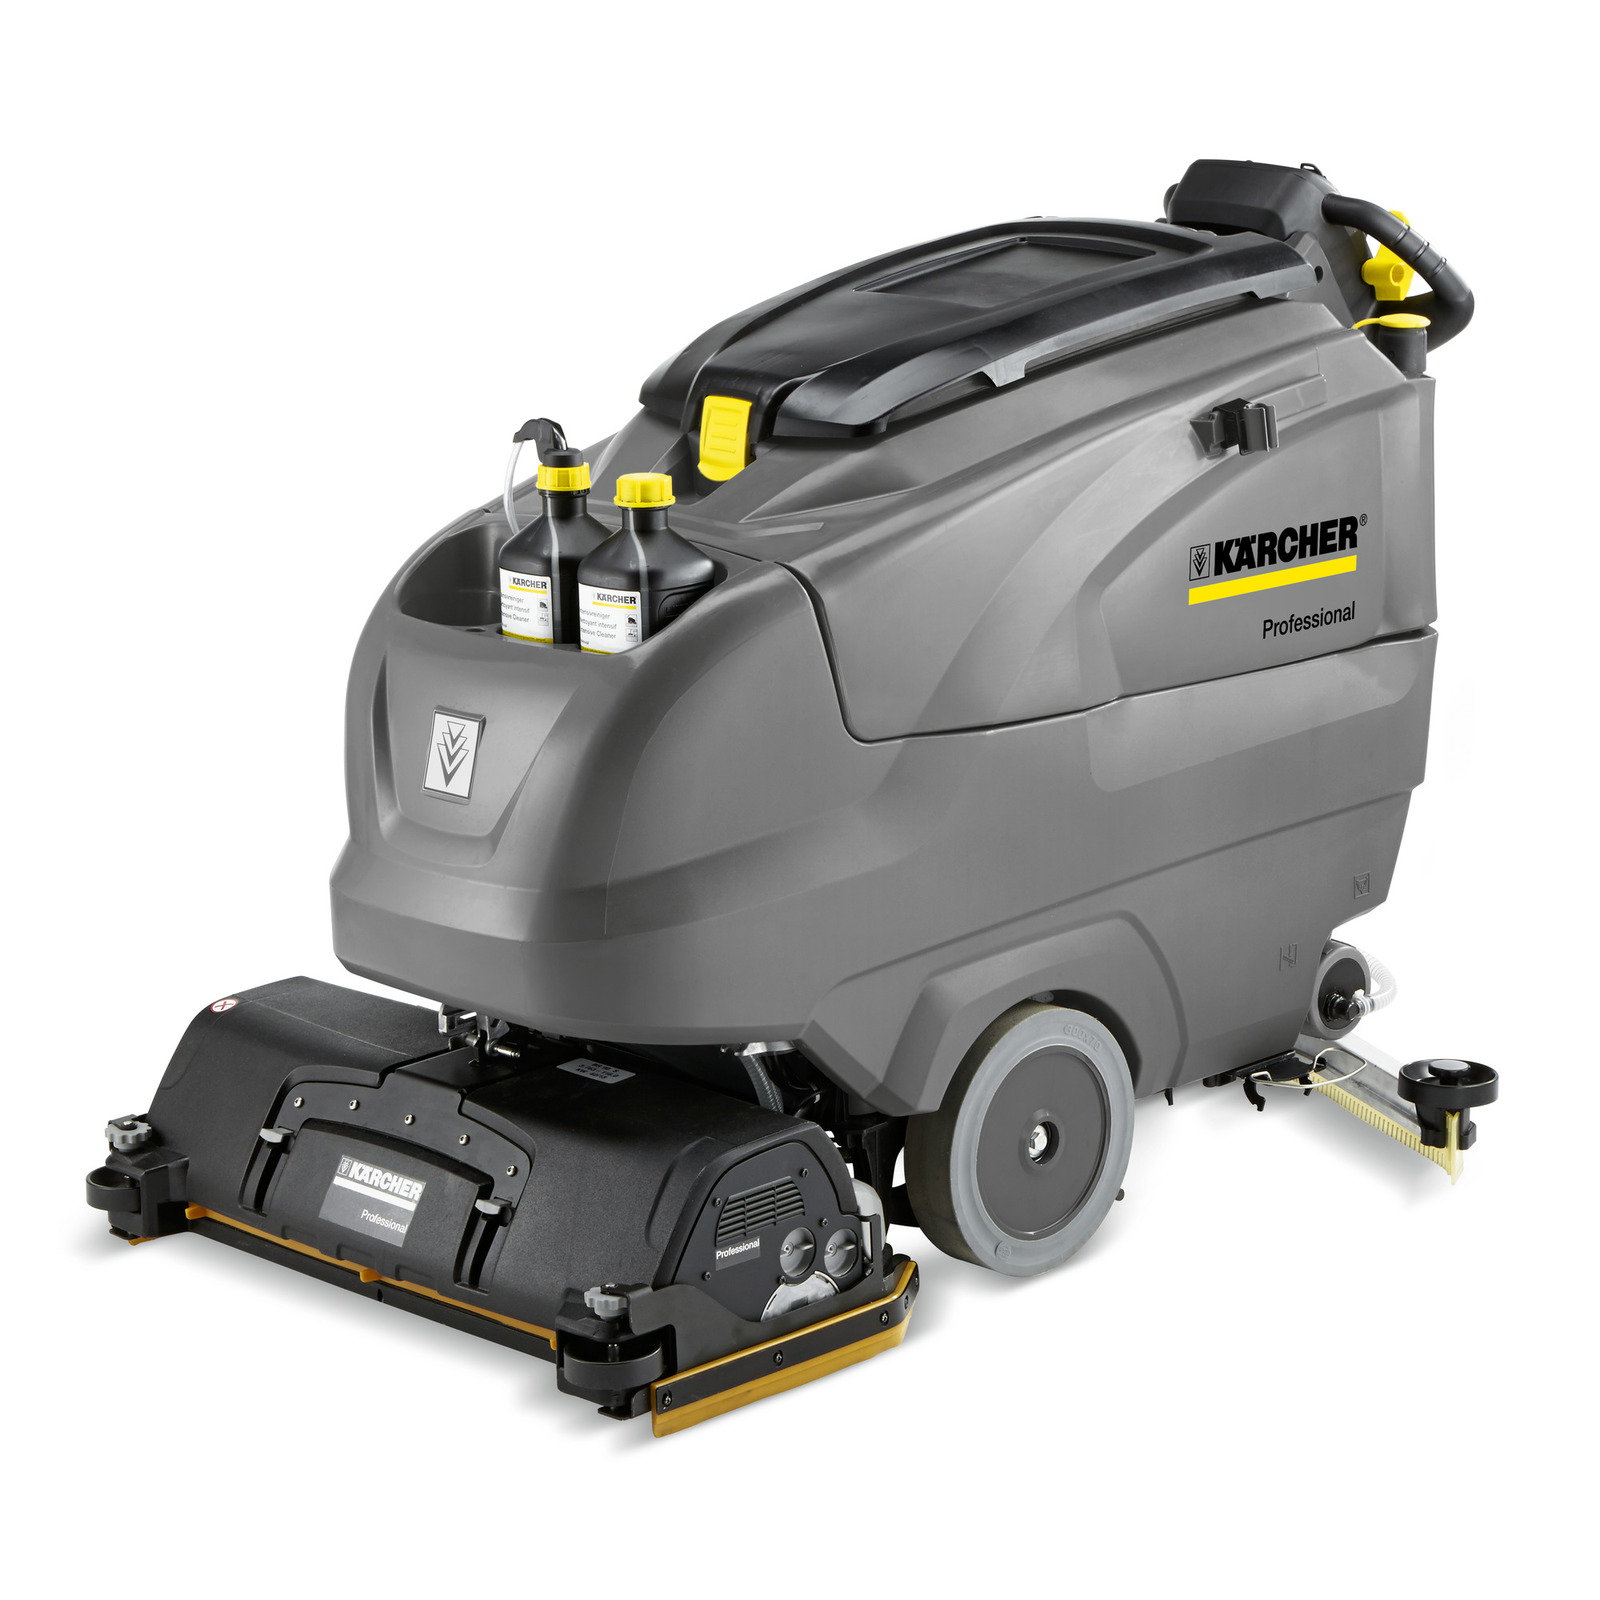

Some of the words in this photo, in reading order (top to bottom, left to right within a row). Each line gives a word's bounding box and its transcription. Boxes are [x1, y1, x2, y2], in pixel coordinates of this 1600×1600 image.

[512, 577, 547, 589] KÄRCHER
[597, 593, 636, 604] KÄRCHER
[1263, 601, 1355, 639] Professional
[596, 630, 617, 640] Cleaner
[349, 1161, 423, 1201] KÄRCHER
[360, 1208, 408, 1234] Professional
[716, 1237, 760, 1261] Professional
